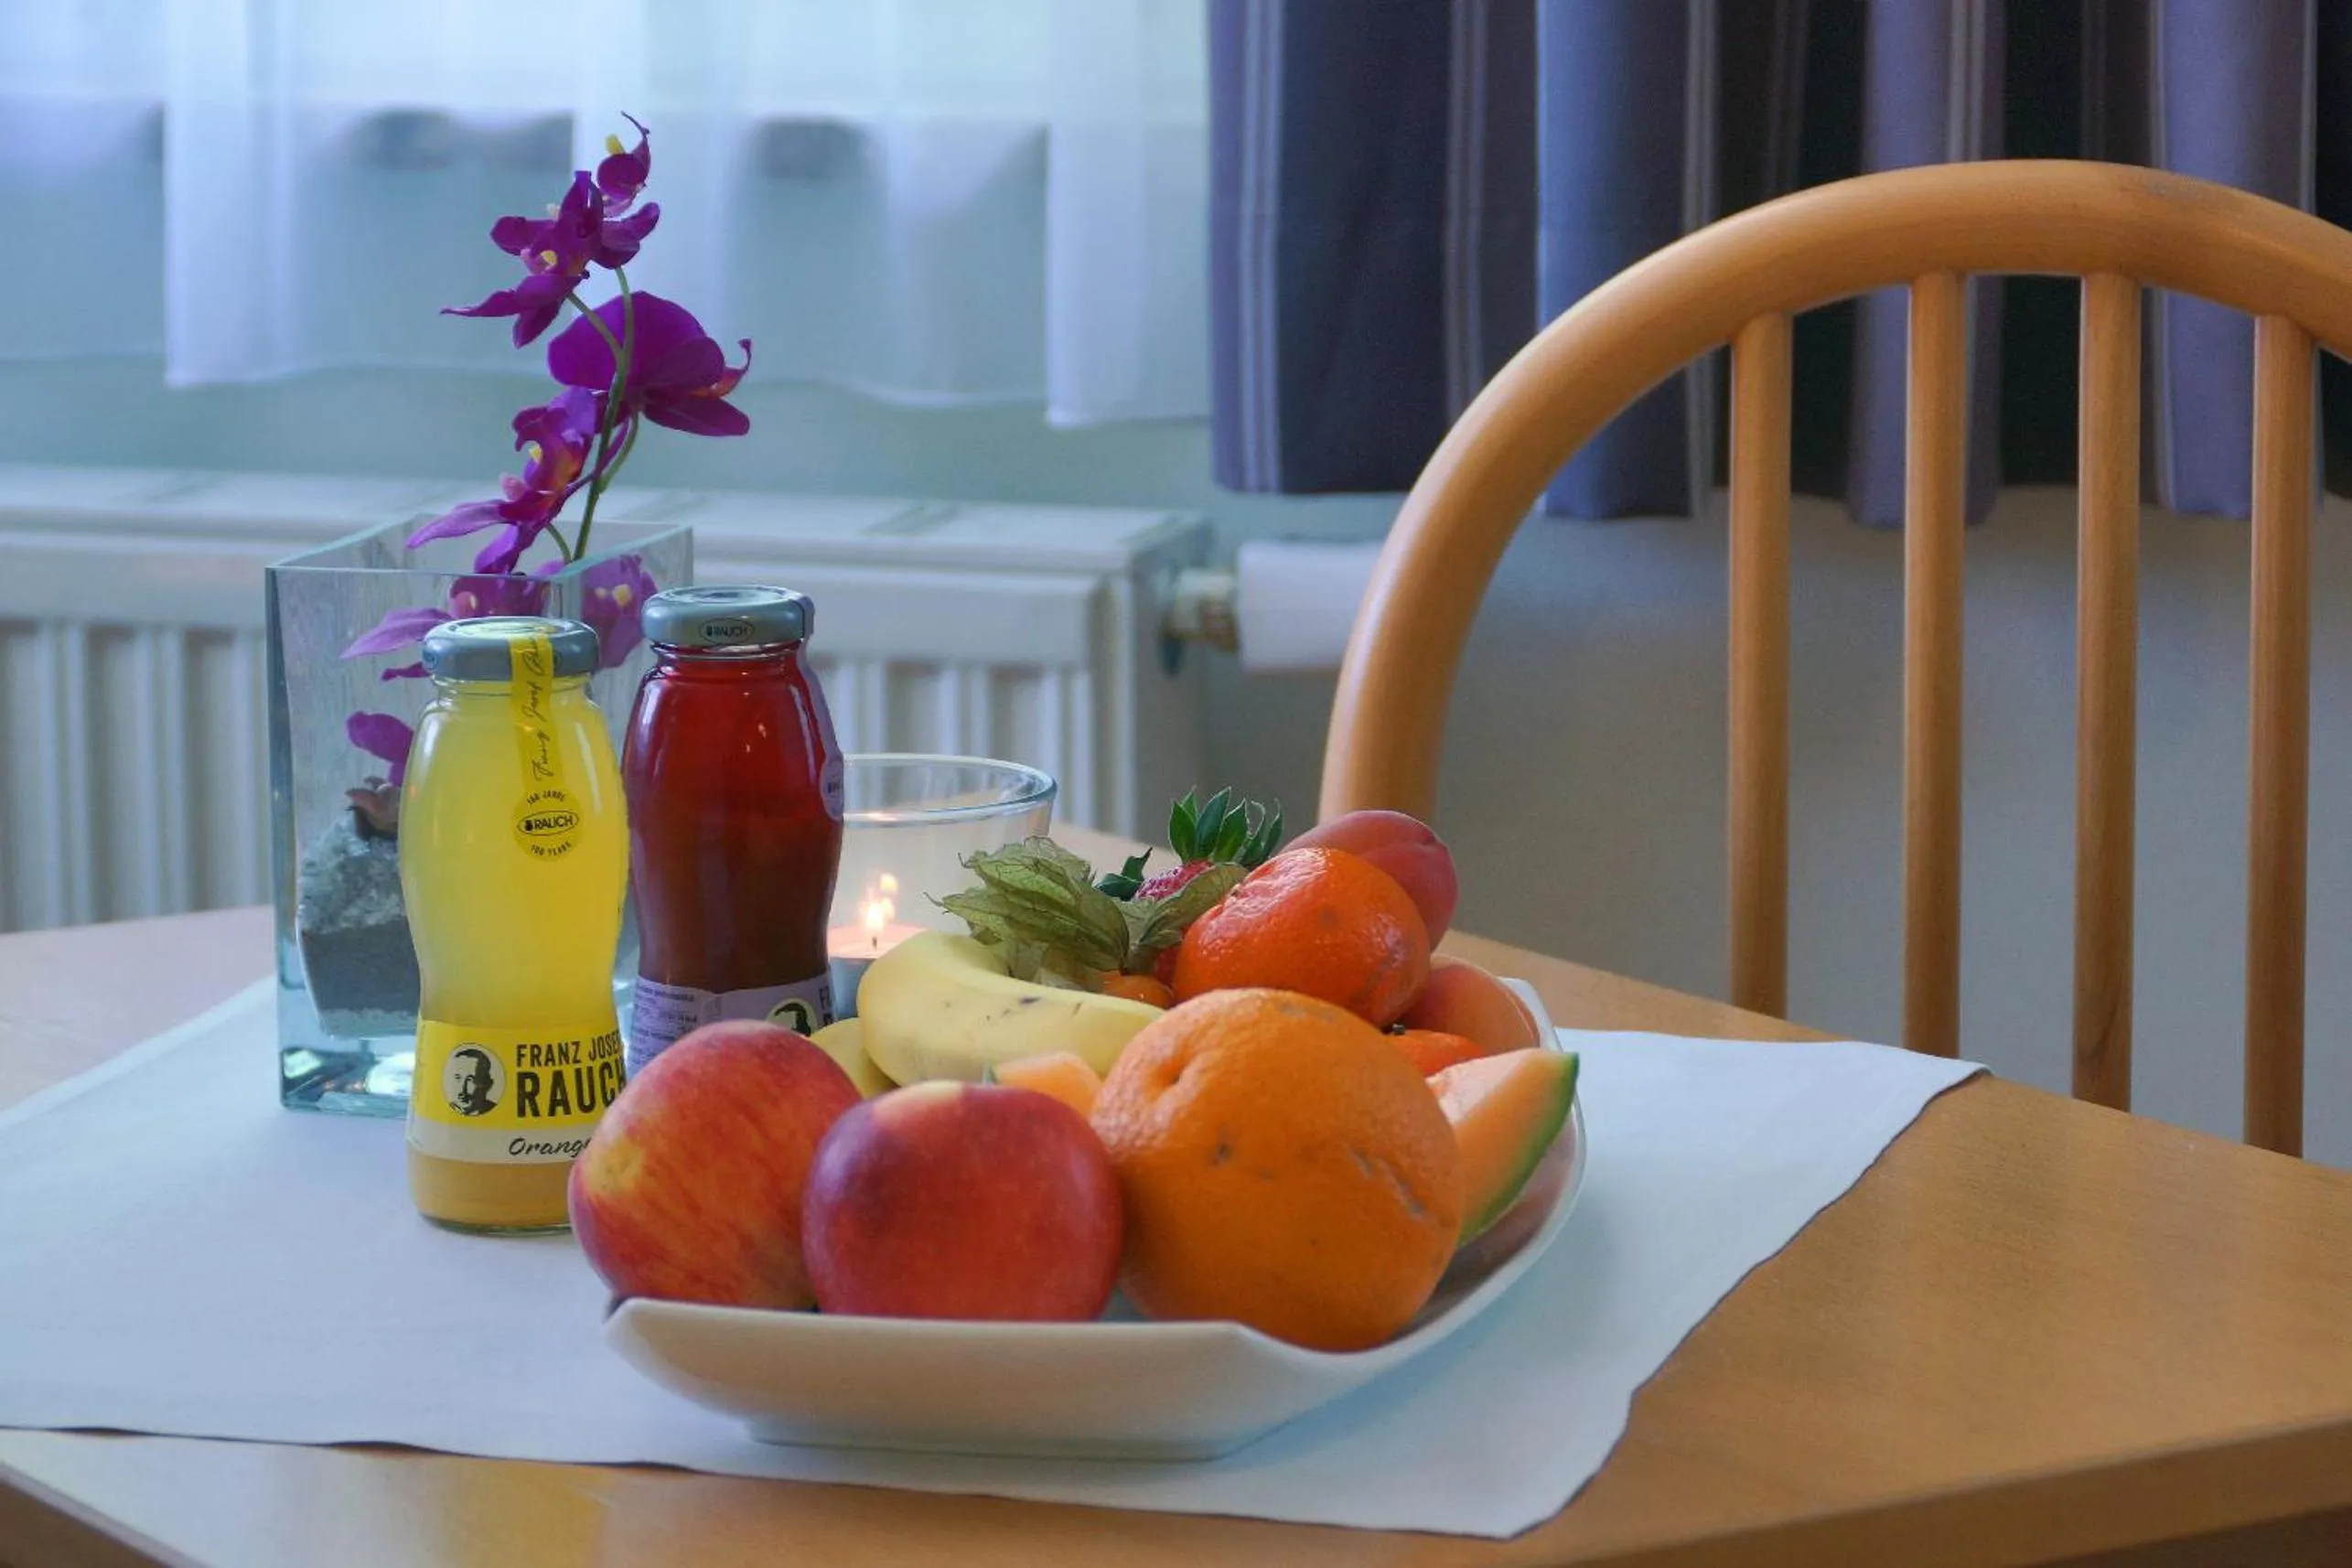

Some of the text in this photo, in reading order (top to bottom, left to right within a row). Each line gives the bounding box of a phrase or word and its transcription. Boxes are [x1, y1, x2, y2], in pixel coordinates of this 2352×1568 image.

[534, 815, 573, 830] RAUCH
[516, 1041, 582, 1068] FRANZ
[516, 1056, 627, 1118] RAUCH
